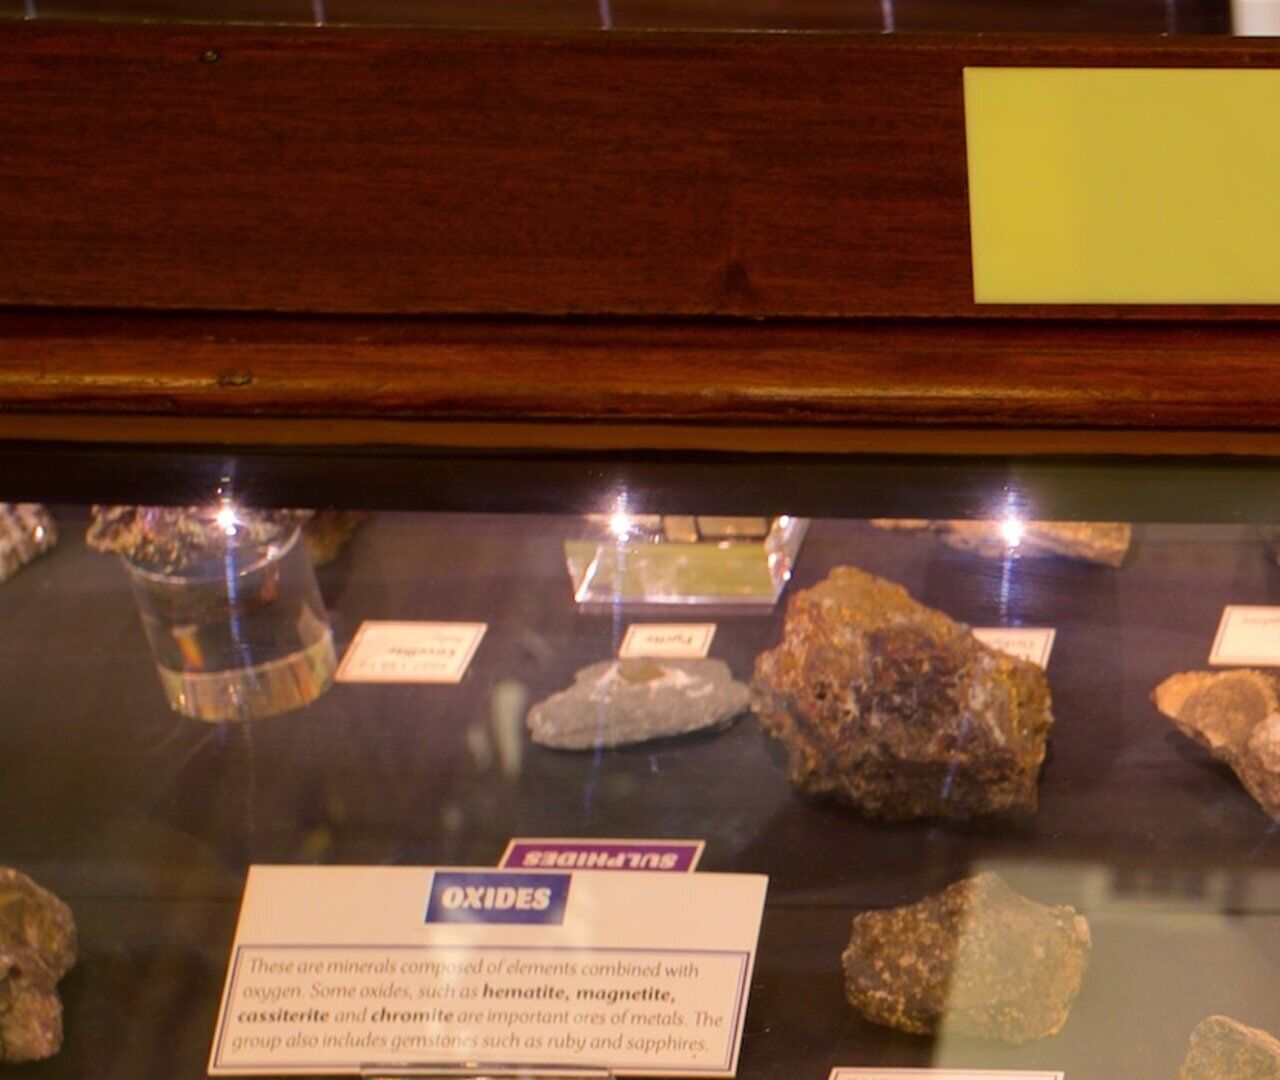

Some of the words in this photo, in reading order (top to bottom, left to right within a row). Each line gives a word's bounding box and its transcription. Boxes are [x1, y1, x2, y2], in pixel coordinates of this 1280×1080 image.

[523, 849, 679, 868] SULPHIDES
[441, 885, 552, 911] OXIDES
[250, 958, 297, 975] These
[304, 962, 323, 974] are
[327, 958, 396, 975] minerals
[400, 960, 482, 978] composed
[506, 960, 577, 976] elements
[581, 961, 660, 978] combined
[665, 962, 699, 978] with
[243, 984, 304, 1001] oxygen.
[310, 982, 356, 997] Some
[360, 984, 413, 1000] oxides,
[419, 984, 455, 999] such
[483, 983, 570, 1001] hematite,
[577, 986, 676, 1004] magnetite,
[238, 1009, 329, 1024] cassiterite
[334, 1008, 366, 1023] and
[371, 1008, 453, 1023] chromite
[487, 1008, 569, 1027] important
[573, 1012, 606, 1024] ores
[631, 1011, 687, 1027] metals.
[694, 1011, 723, 1027] The
[232, 1034, 281, 1052] group
[286, 1032, 318, 1048] also
[322, 1033, 387, 1048] includes
[392, 1035, 478, 1052] gemstones
[482, 1034, 520, 1048] such
[548, 1034, 586, 1053] ruby
[590, 1034, 622, 1050] and
